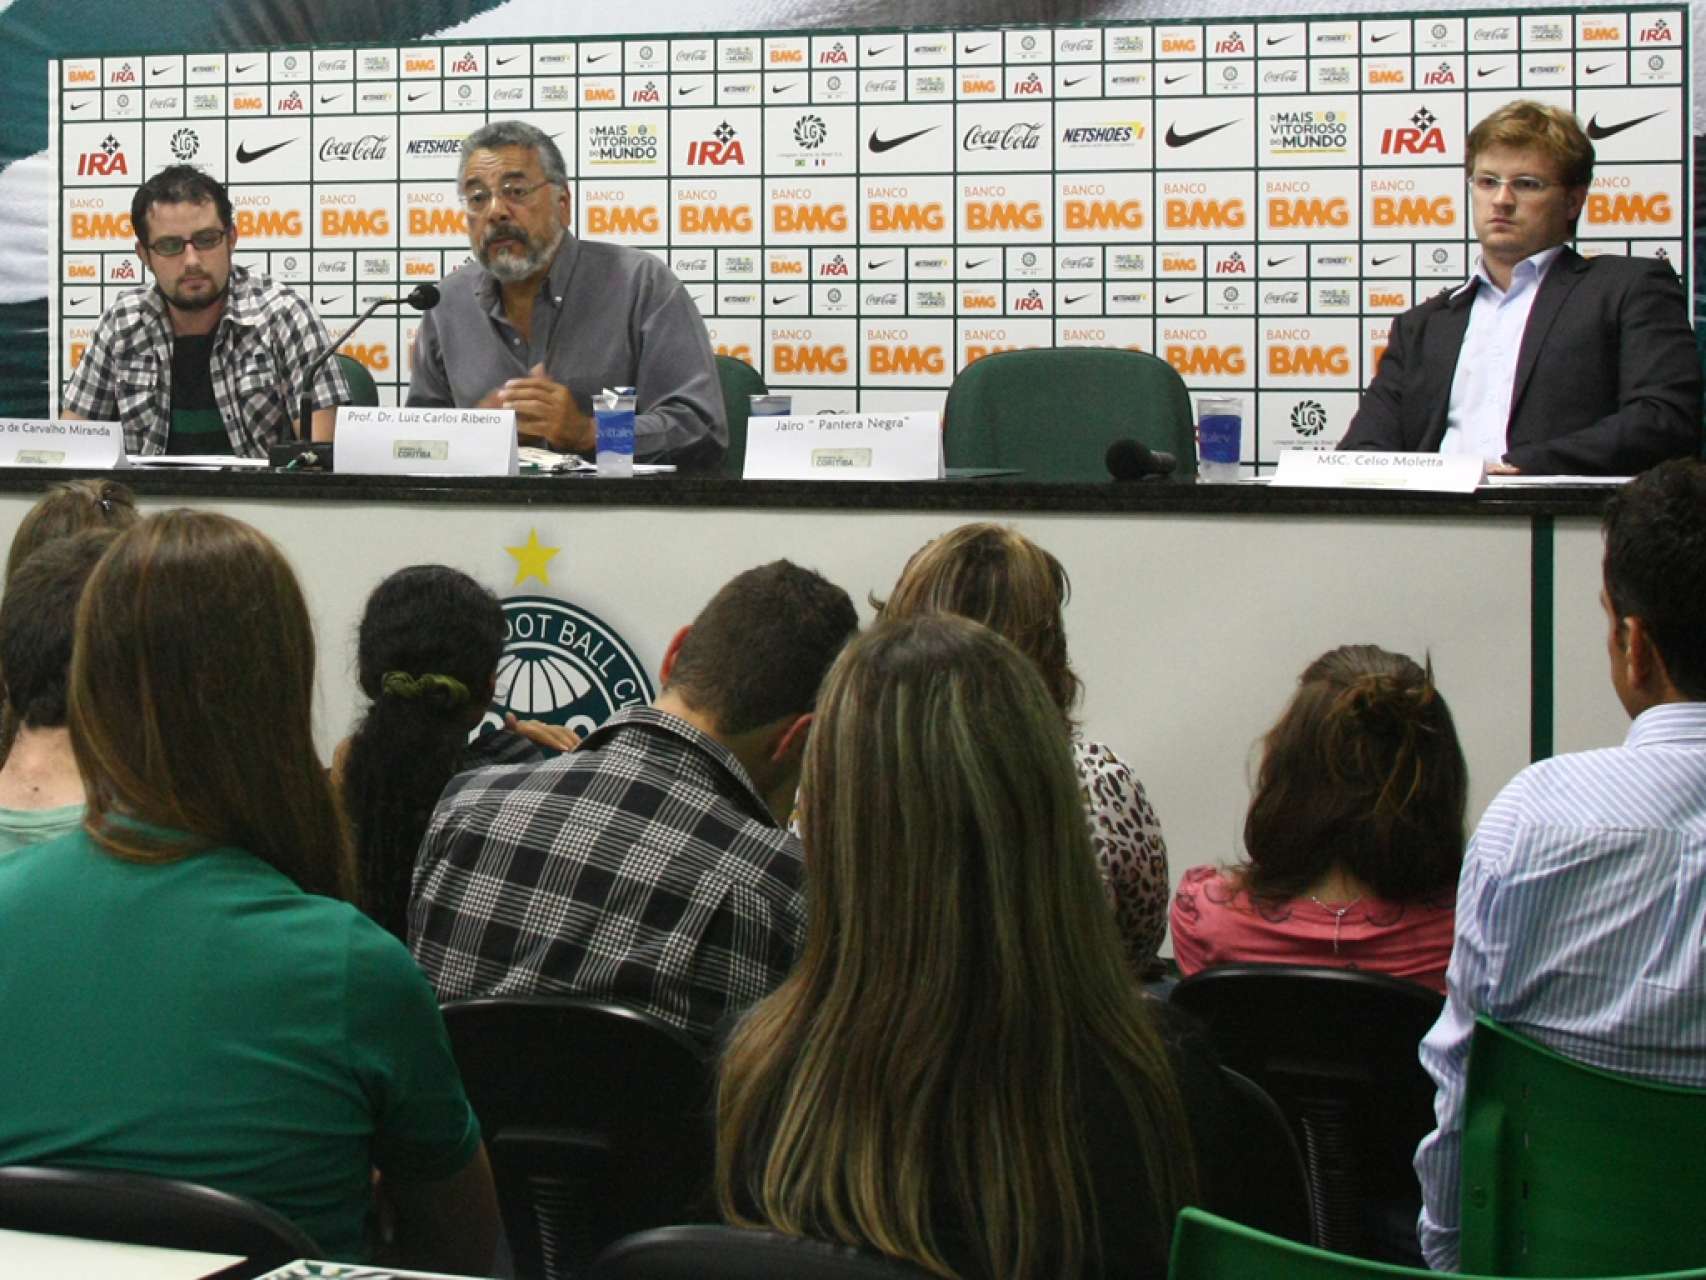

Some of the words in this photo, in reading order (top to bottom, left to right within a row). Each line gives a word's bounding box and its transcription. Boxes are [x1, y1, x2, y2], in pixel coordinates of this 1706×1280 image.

[1584, 28, 1619, 40] BMG
[1641, 29, 1671, 41] IRA
[1162, 40, 1195, 52] BMG
[1215, 41, 1245, 53] IRA
[770, 50, 802, 63] BMG
[820, 52, 848, 63] IRA
[406, 60, 435, 71] BMG
[453, 61, 478, 72] IRA
[68, 71, 95, 82] BMG
[112, 72, 135, 82] IRA
[1369, 71, 1404, 83] BMG
[1424, 73, 1455, 84] IRA
[963, 80, 995, 93] BMG
[1014, 82, 1043, 93] IRA
[585, 89, 615, 101] BMG
[633, 90, 659, 102] IRA
[234, 98, 262, 110] BMG
[278, 100, 303, 110] IRA
[1277, 113, 1313, 123] MAIS
[595, 125, 628, 135] MAIS
[804, 125, 816, 139] LG
[1270, 123, 1347, 134] VITORIOSO
[590, 136, 656, 146] VITORIOSO
[1063, 128, 1132, 143] NETSHOES
[1282, 135, 1346, 147] MUNDO
[1381, 128, 1446, 154] IRA
[179, 138, 191, 151] LG
[600, 147, 657, 159] MUNDO
[687, 140, 744, 166] IRA
[78, 153, 128, 175] IRA
[1164, 183, 1206, 194] BANCO
[1266, 182, 1310, 192] BANCO
[1371, 180, 1415, 192] BANCO
[1593, 177, 1630, 188] ANCO
[586, 191, 624, 202] BANCO
[678, 190, 717, 200] BANCO
[772, 189, 811, 200] BANCO
[867, 188, 907, 198] BANCO
[964, 186, 1006, 197] BANCO
[1063, 185, 1105, 196] BANCO
[70, 198, 104, 208] BANCO
[235, 195, 270, 206] BANCO
[320, 195, 356, 205] BANCO
[407, 193, 444, 203] BANCO
[1066, 201, 1143, 229] BMG
[1167, 200, 1245, 228] BMG
[1269, 198, 1349, 227] BMG
[1374, 197, 1456, 226] BMG
[1588, 195, 1671, 224] BMG
[588, 207, 659, 234] BMG
[680, 206, 752, 232] BMG
[774, 205, 847, 232] BMG
[870, 204, 944, 231] BMG
[967, 203, 1043, 230] BMG
[71, 213, 134, 239] BMG
[237, 210, 302, 237] BMG
[322, 210, 389, 236] BMG
[406, 263, 435, 275] BMG
[771, 262, 802, 273] BMG
[821, 264, 848, 276] IRA
[1163, 258, 1196, 271] BMG
[1216, 261, 1246, 273] IRA
[69, 266, 96, 277] BMG
[112, 268, 135, 278] IRA
[963, 296, 996, 308] BMG
[1015, 298, 1043, 310] IRA
[1370, 294, 1404, 307] BMG
[772, 329, 812, 340] BANCO
[868, 330, 908, 340] BANCO
[965, 330, 1006, 340] BANCO
[1063, 330, 1105, 341] BANCO
[1164, 330, 1207, 340] BANCO
[1267, 329, 1310, 340] BANCO
[774, 345, 848, 373] BMG
[869, 346, 944, 374] BMG
[1166, 346, 1244, 374] BMG
[1269, 346, 1349, 375] BMG
[348, 411, 373, 422] Prof.
[378, 411, 393, 422] Dr.
[399, 412, 420, 423] Luiz
[423, 412, 457, 424] Carlos
[461, 413, 501, 424] Ribeiro
[1301, 412, 1316, 426] LG
[8, 424, 18, 433] de
[22, 423, 65, 434] Carvalho
[70, 425, 111, 437] Miranda
[776, 421, 804, 432] Jairo
[819, 419, 863, 431] Pantera
[1355, 455, 1389, 466] Celso
[1393, 456, 1443, 468] Moletta
[558, 620, 616, 678] BALL
